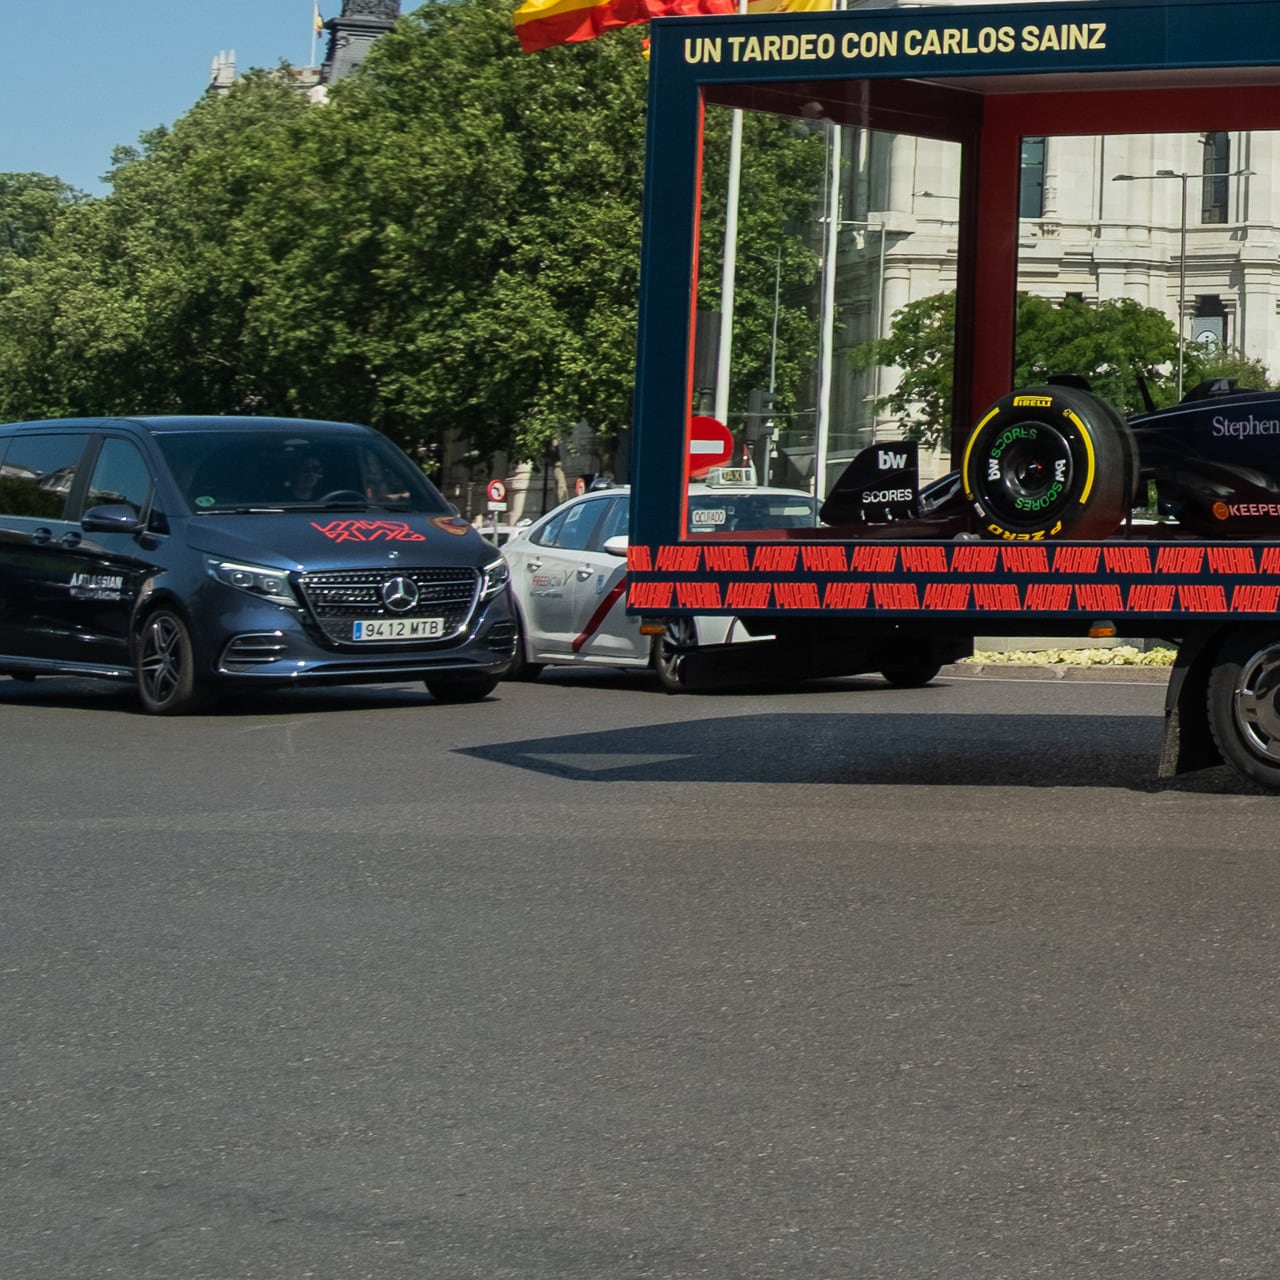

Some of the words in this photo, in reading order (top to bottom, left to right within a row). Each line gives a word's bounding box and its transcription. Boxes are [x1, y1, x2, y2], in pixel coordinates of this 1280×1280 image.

[684, 37, 722, 64] UN
[727, 32, 835, 61] TARDEO
[841, 30, 898, 58] CON
[904, 26, 1014, 56] CARLOS
[1021, 23, 1106, 52] SAINZ
[1013, 395, 1053, 407] PIRELLI
[721, 470, 743, 481] TAX
[862, 488, 912, 503] SCORES
[1015, 482, 1064, 511] SCORES
[987, 523, 1046, 541] ZERO
[626, 546, 652, 573] RING
[655, 546, 701, 573] MADRING
[704, 546, 749, 573] MADRING
[752, 546, 799, 573] MADRING
[801, 546, 848, 573] MADRING
[849, 546, 898, 573] MADRING
[901, 547, 948, 572] MADRING
[950, 547, 999, 572] MADRING
[1001, 547, 1049, 572] MADRING
[1052, 547, 1101, 573] MADRING
[1103, 547, 1152, 573] MADRING
[1155, 547, 1205, 573] MADRING
[1207, 548, 1256, 573] MADRING
[627, 583, 674, 608] MADRING
[676, 583, 722, 608] MADRING
[725, 583, 771, 608] MADRING
[774, 583, 820, 608] MADRING
[823, 583, 870, 608] MADRING
[872, 583, 919, 609] MADRING
[922, 584, 971, 610] MADRING
[973, 584, 1021, 610] MADRING
[1024, 584, 1072, 610] MADRING
[1075, 584, 1124, 611] MADRING
[1127, 585, 1176, 611] MADRING
[1178, 585, 1227, 612] MADRING
[1230, 586, 1280, 612] MADRING
[366, 623, 405, 637] 9412
[410, 621, 438, 635] MTB
